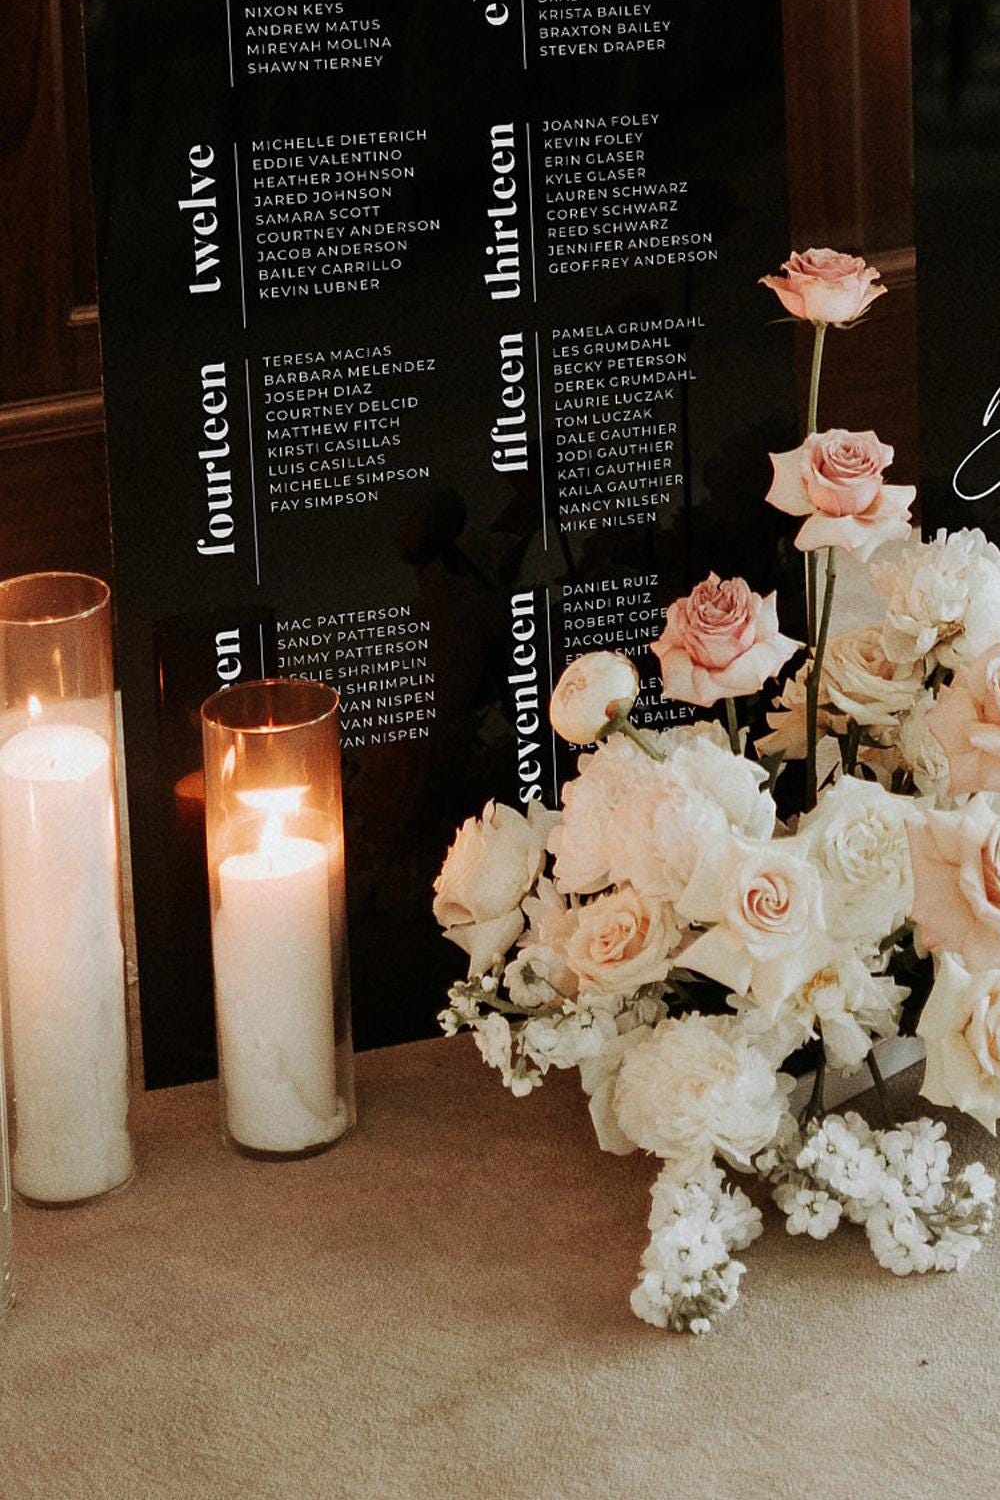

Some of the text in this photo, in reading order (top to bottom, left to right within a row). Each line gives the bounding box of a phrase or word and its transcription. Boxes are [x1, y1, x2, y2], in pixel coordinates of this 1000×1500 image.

[245, 2, 344, 19] NIXON KEYS
[245, 19, 381, 37] ANDREW MATUS
[247, 36, 392, 56] MIREYAH MOLINA
[247, 55, 383, 75] SHAWN TIERNEY
[542, 113, 659, 132] JOANNA FOLEY
[544, 132, 643, 150] KEVIN FOLEY
[544, 149, 645, 168] ERIN GLASER
[545, 167, 646, 185] KYLE GLASER
[546, 181, 688, 203] LAUREN SCHWARZ
[178, 145, 221, 293] twelve
[484, 123, 520, 299] thirteen
[546, 200, 678, 221] COREY SCHWARZ
[548, 218, 668, 238] REED SCHWARZ
[548, 232, 712, 256] JENNIFER ANDERSON
[548, 250, 718, 274] GEOFFREY ANDERSON
[262, 345, 392, 368] TERESA MACIAS
[264, 359, 435, 386] BARBARA MELENDEZ
[265, 383, 373, 404] JOSEPH DIAZ
[491, 332, 528, 471] fifteen
[265, 397, 418, 422] COURTNEY DELCID
[267, 416, 400, 441] MATTHEW FITCH
[267, 434, 401, 458] KIRSTI CASILLAS
[197, 362, 235, 554] fourteen
[268, 453, 386, 477] LUIS CASILLAS
[270, 466, 429, 495] MICHELLE SIMPSON
[270, 490, 378, 513] FAY SIMPSON
[508, 591, 542, 803] seventeen
